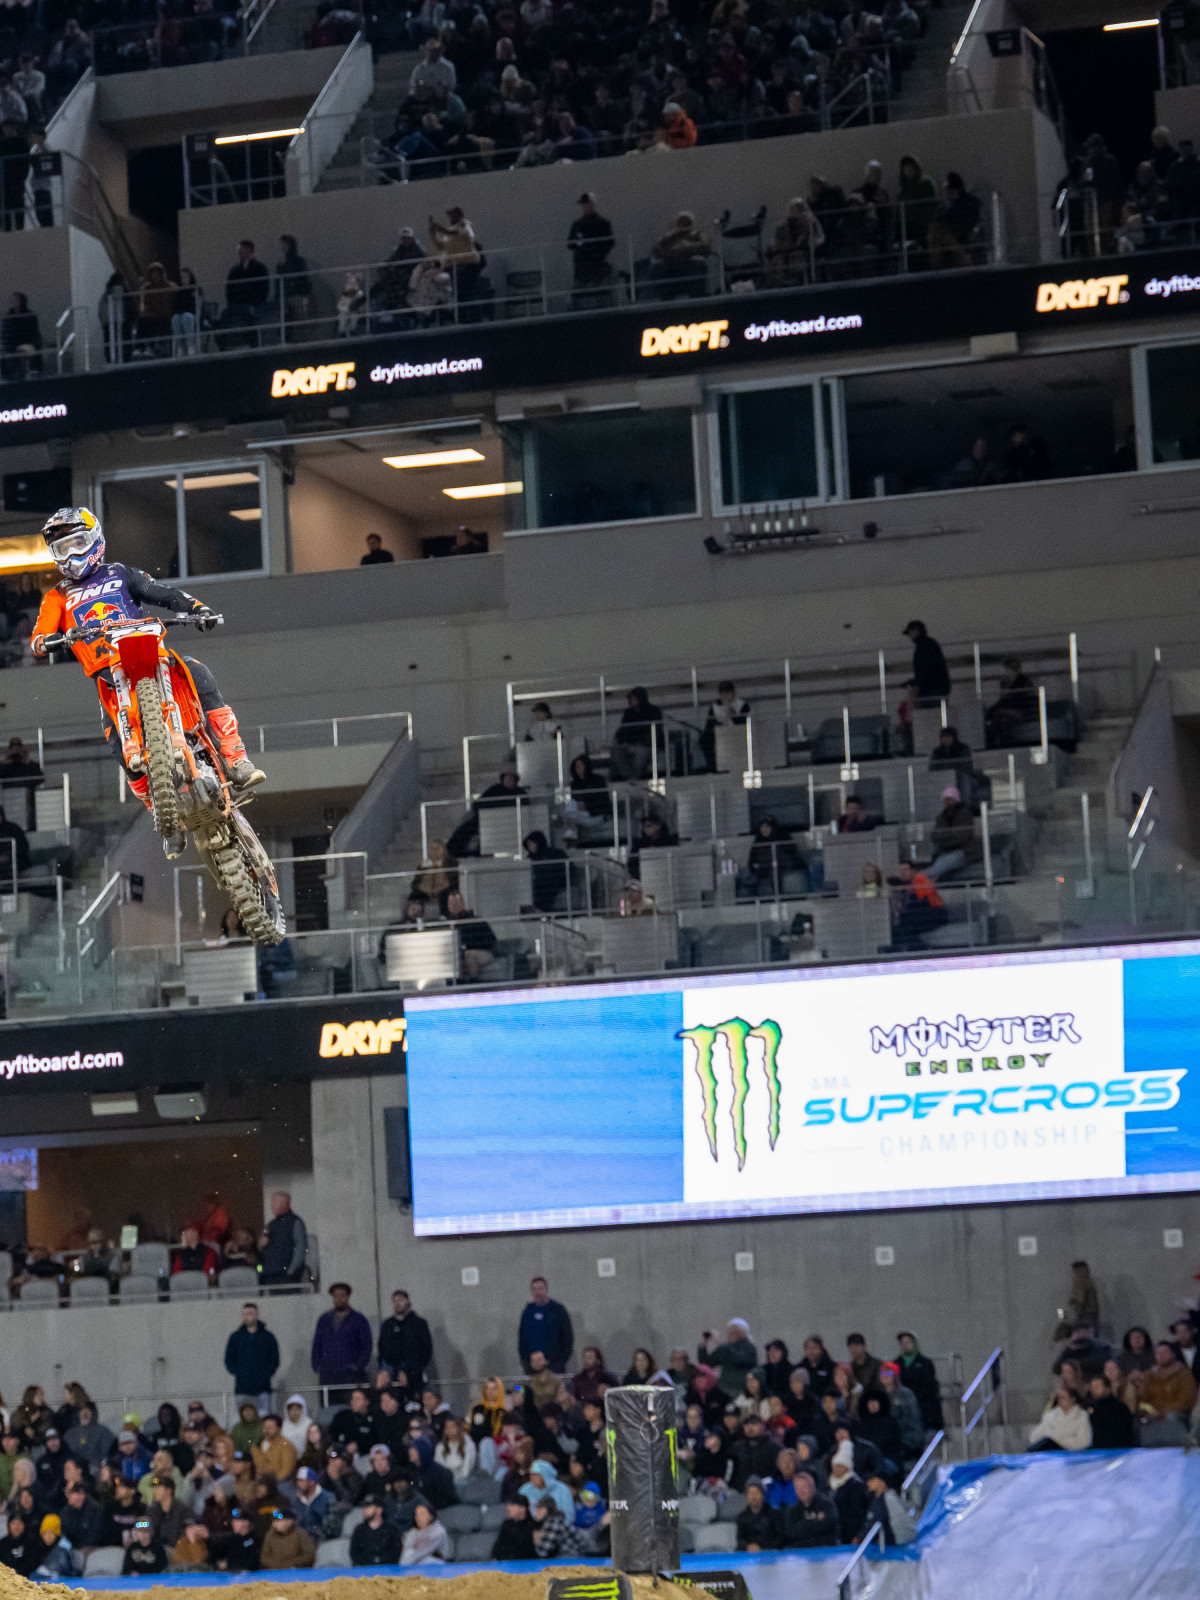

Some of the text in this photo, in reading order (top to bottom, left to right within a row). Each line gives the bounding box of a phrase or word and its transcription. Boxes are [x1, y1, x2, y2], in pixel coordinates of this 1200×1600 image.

[744, 315, 862, 341] dryftboard.com
[371, 358, 482, 384] dryftboard.com
[869, 1013, 1082, 1057] MONSTER
[905, 1053, 1053, 1076] ENERGY
[811, 1076, 852, 1091] AMA
[802, 1076, 1179, 1127] SUPERCROSS
[880, 1124, 1099, 1157] CHAMPIONSHIP
